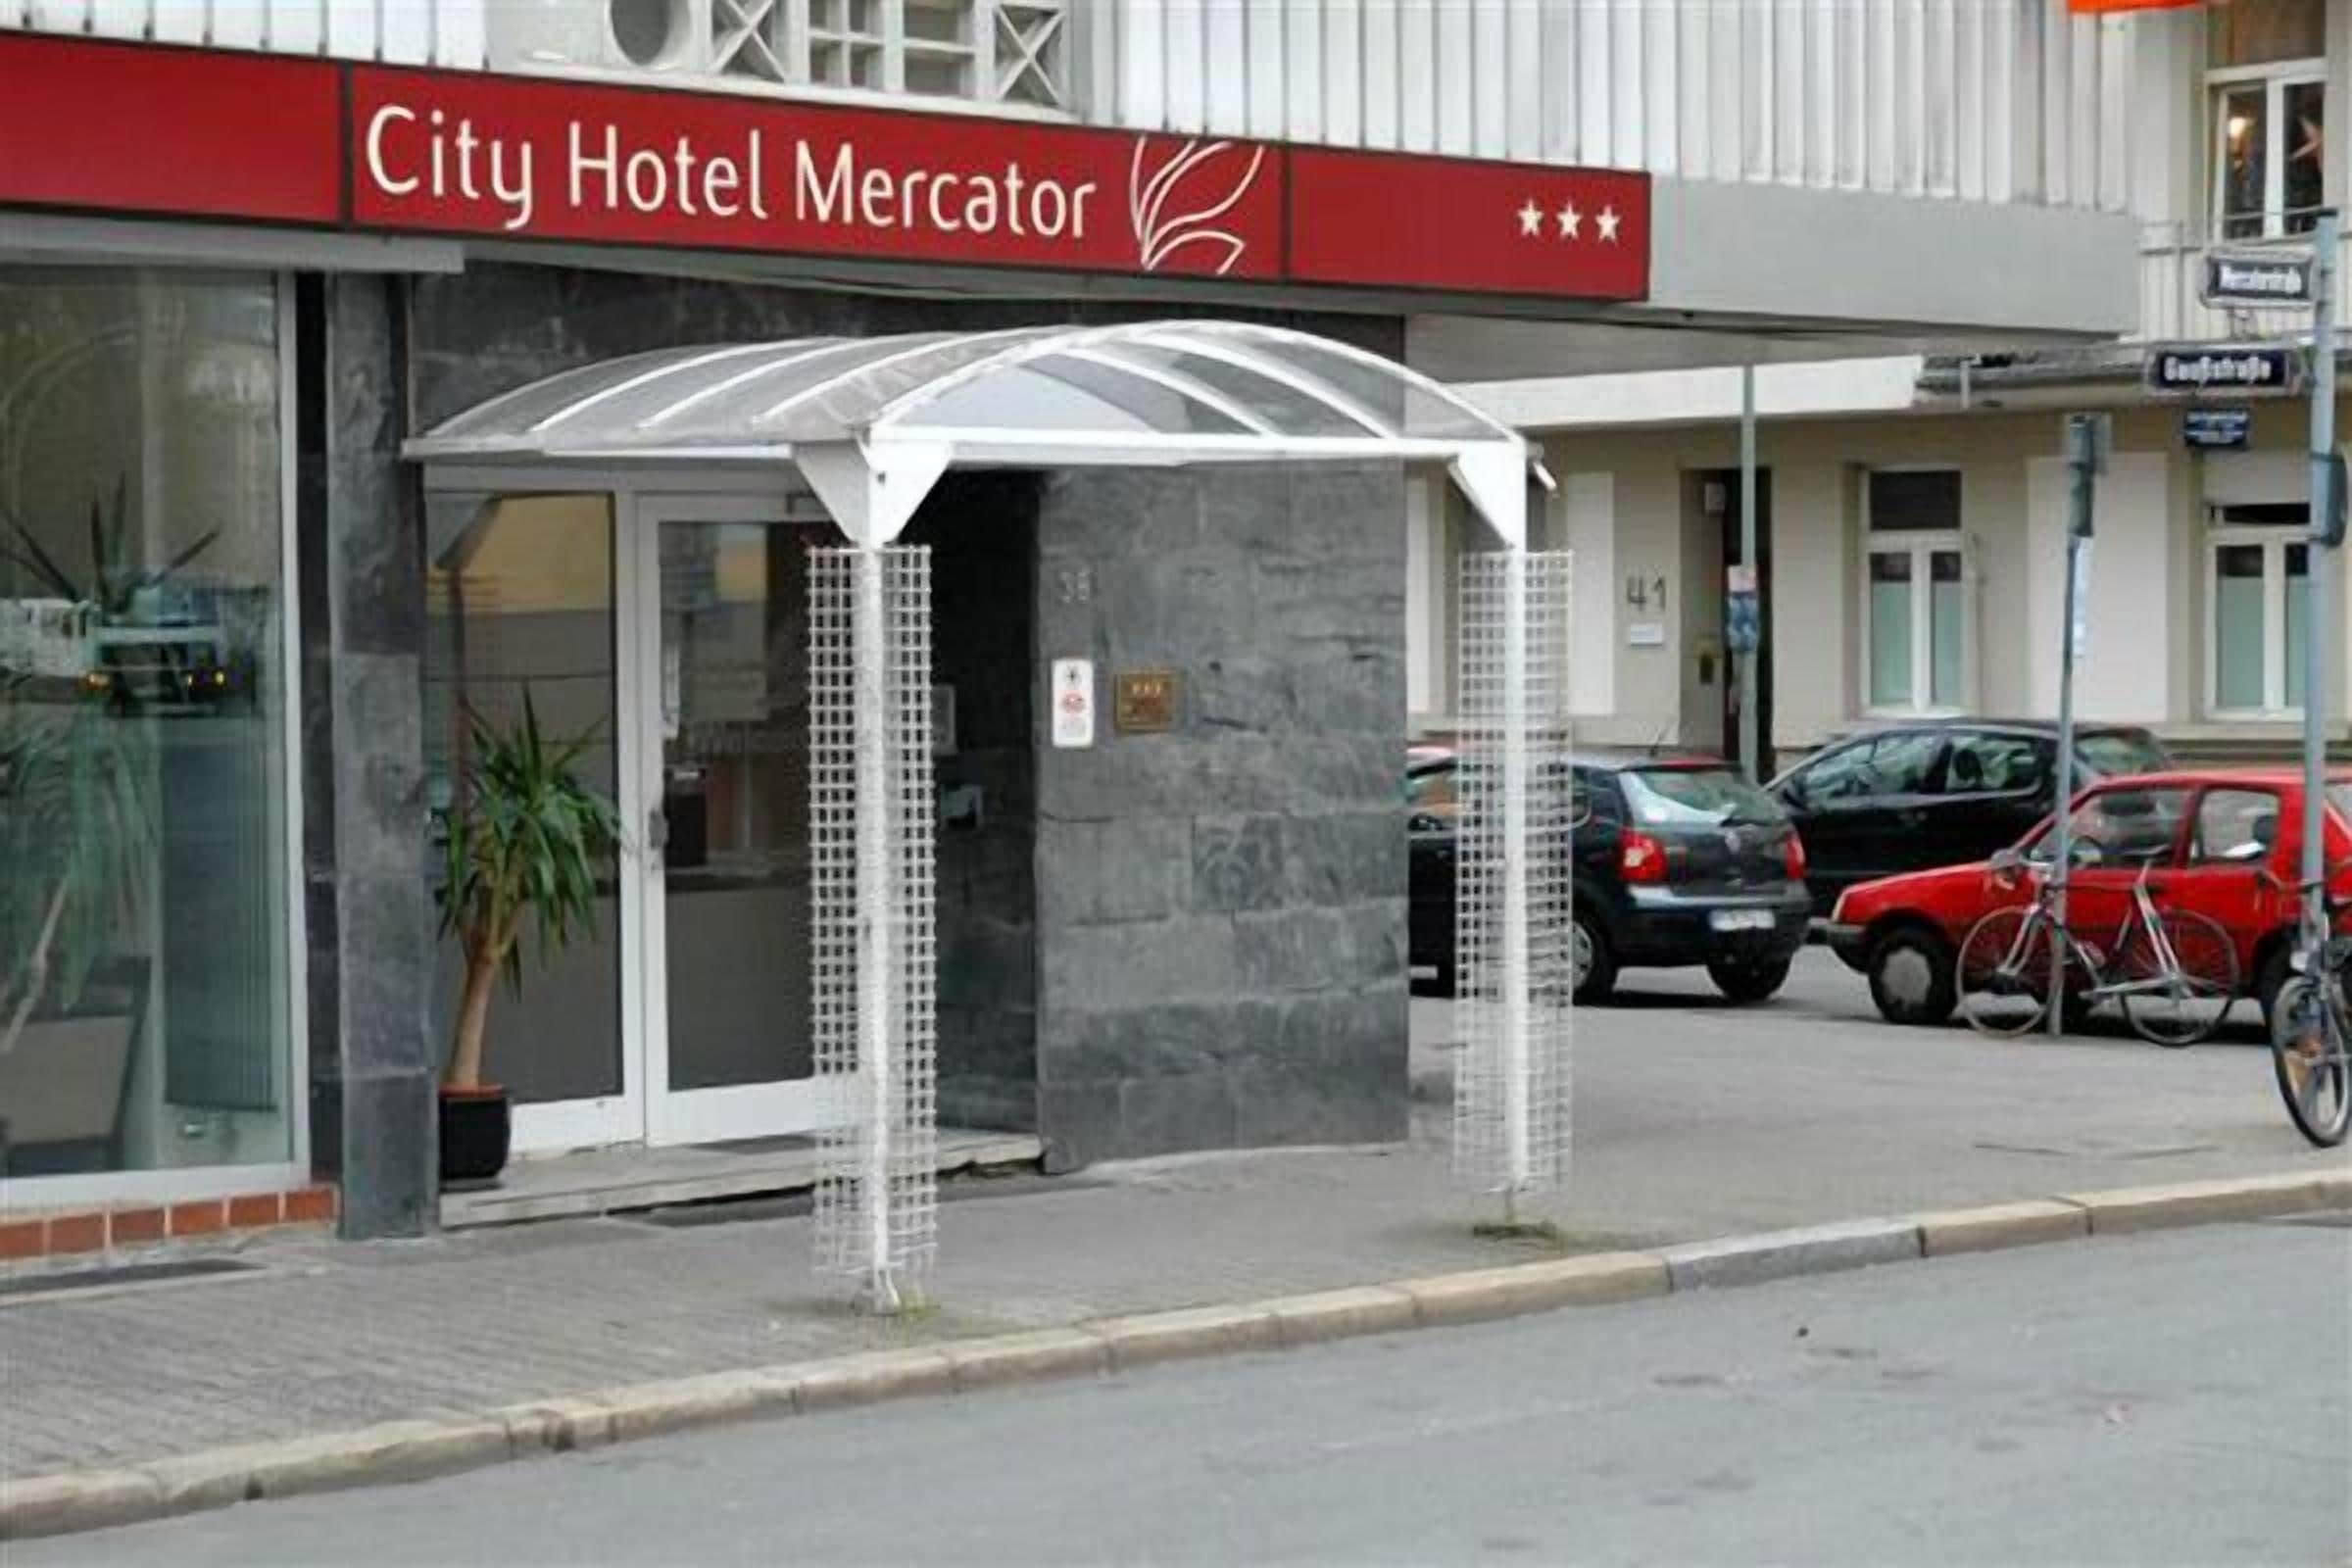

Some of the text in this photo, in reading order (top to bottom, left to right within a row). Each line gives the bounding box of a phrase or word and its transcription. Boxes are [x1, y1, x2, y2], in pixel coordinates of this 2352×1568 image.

[366, 105, 1097, 239] City Hotel Mercator
[1627, 576, 1666, 612] 41
